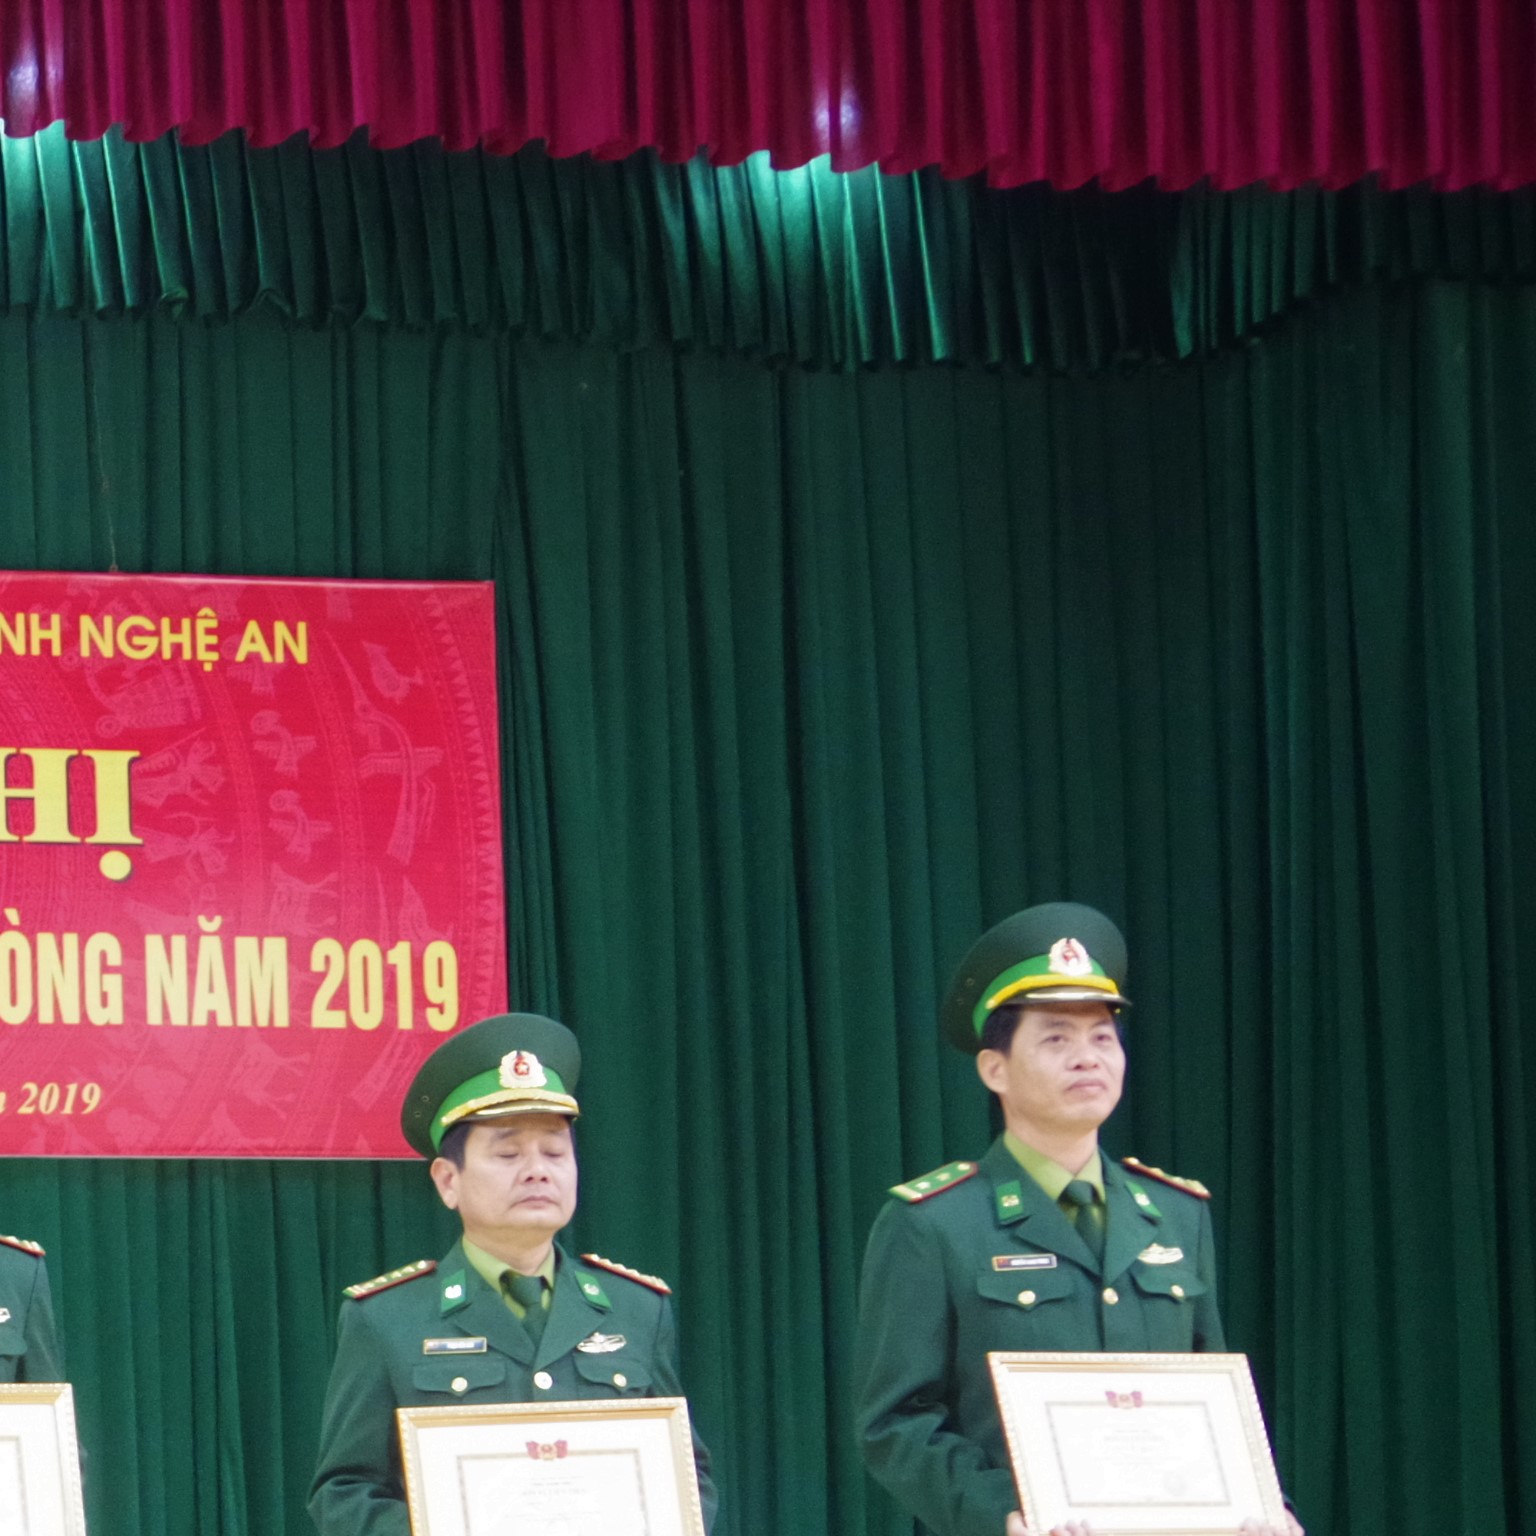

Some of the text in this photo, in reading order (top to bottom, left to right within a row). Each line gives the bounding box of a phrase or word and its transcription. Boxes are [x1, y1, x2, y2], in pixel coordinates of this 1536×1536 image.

[79, 607, 220, 672] NGHỆ
[235, 620, 308, 664] AN
[144, 915, 291, 1029] NĂM
[310, 937, 459, 1032] 2019
[17, 1081, 102, 1115] 2019
